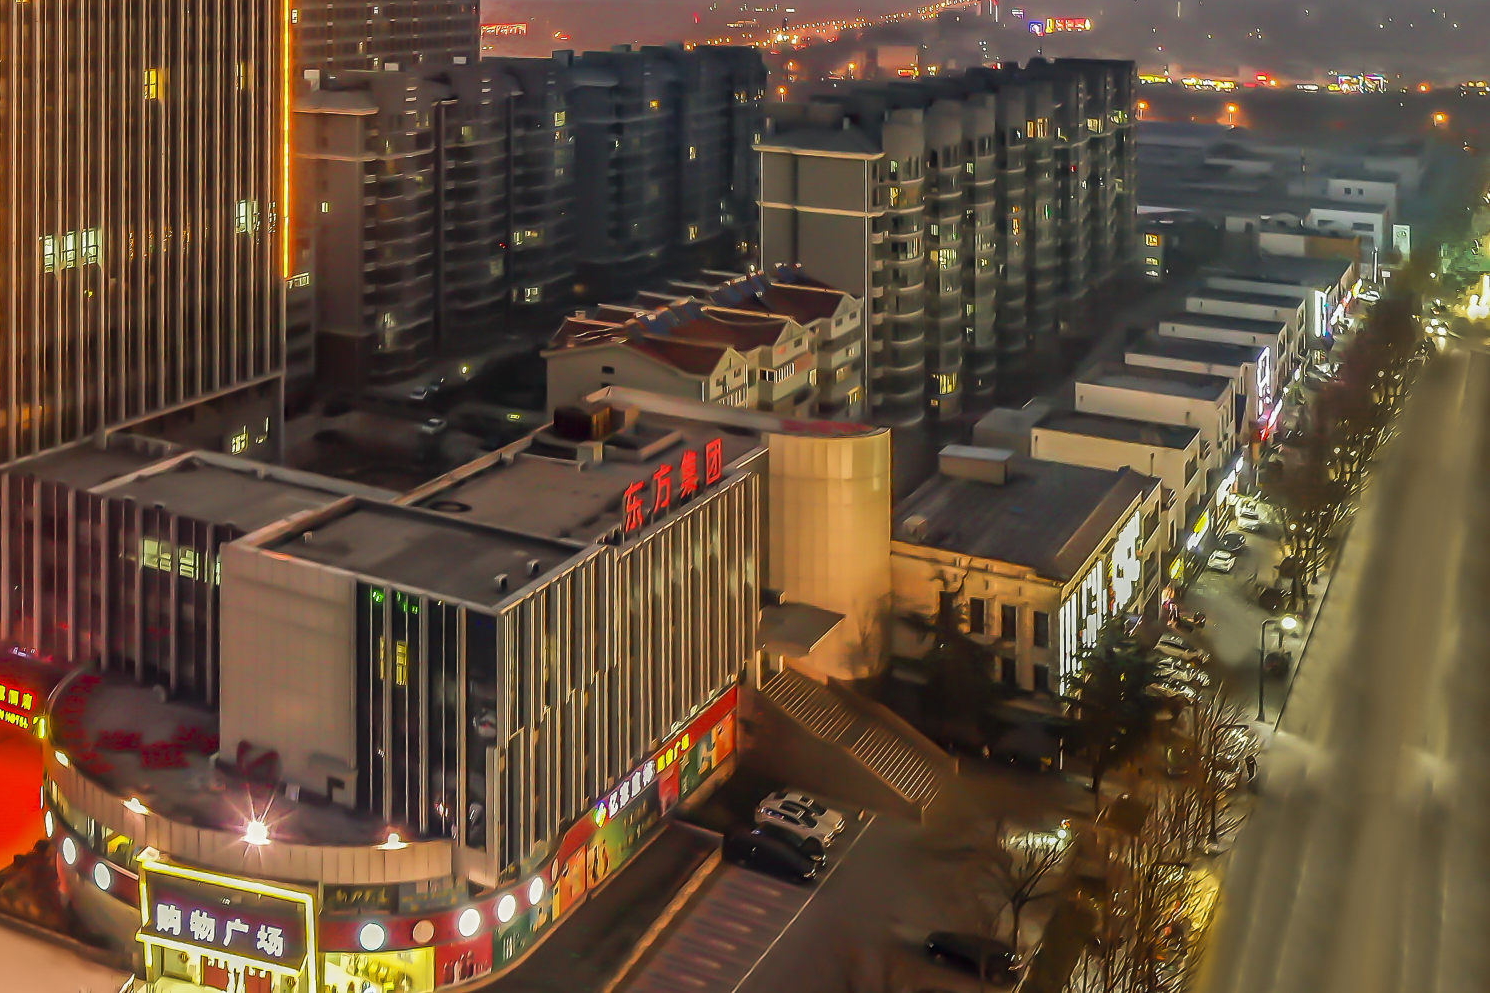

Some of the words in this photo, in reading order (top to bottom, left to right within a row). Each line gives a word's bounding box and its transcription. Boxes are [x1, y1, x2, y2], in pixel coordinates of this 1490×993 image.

[623, 437, 723, 533] 东方集团
[155, 903, 284, 957] 购物广场
